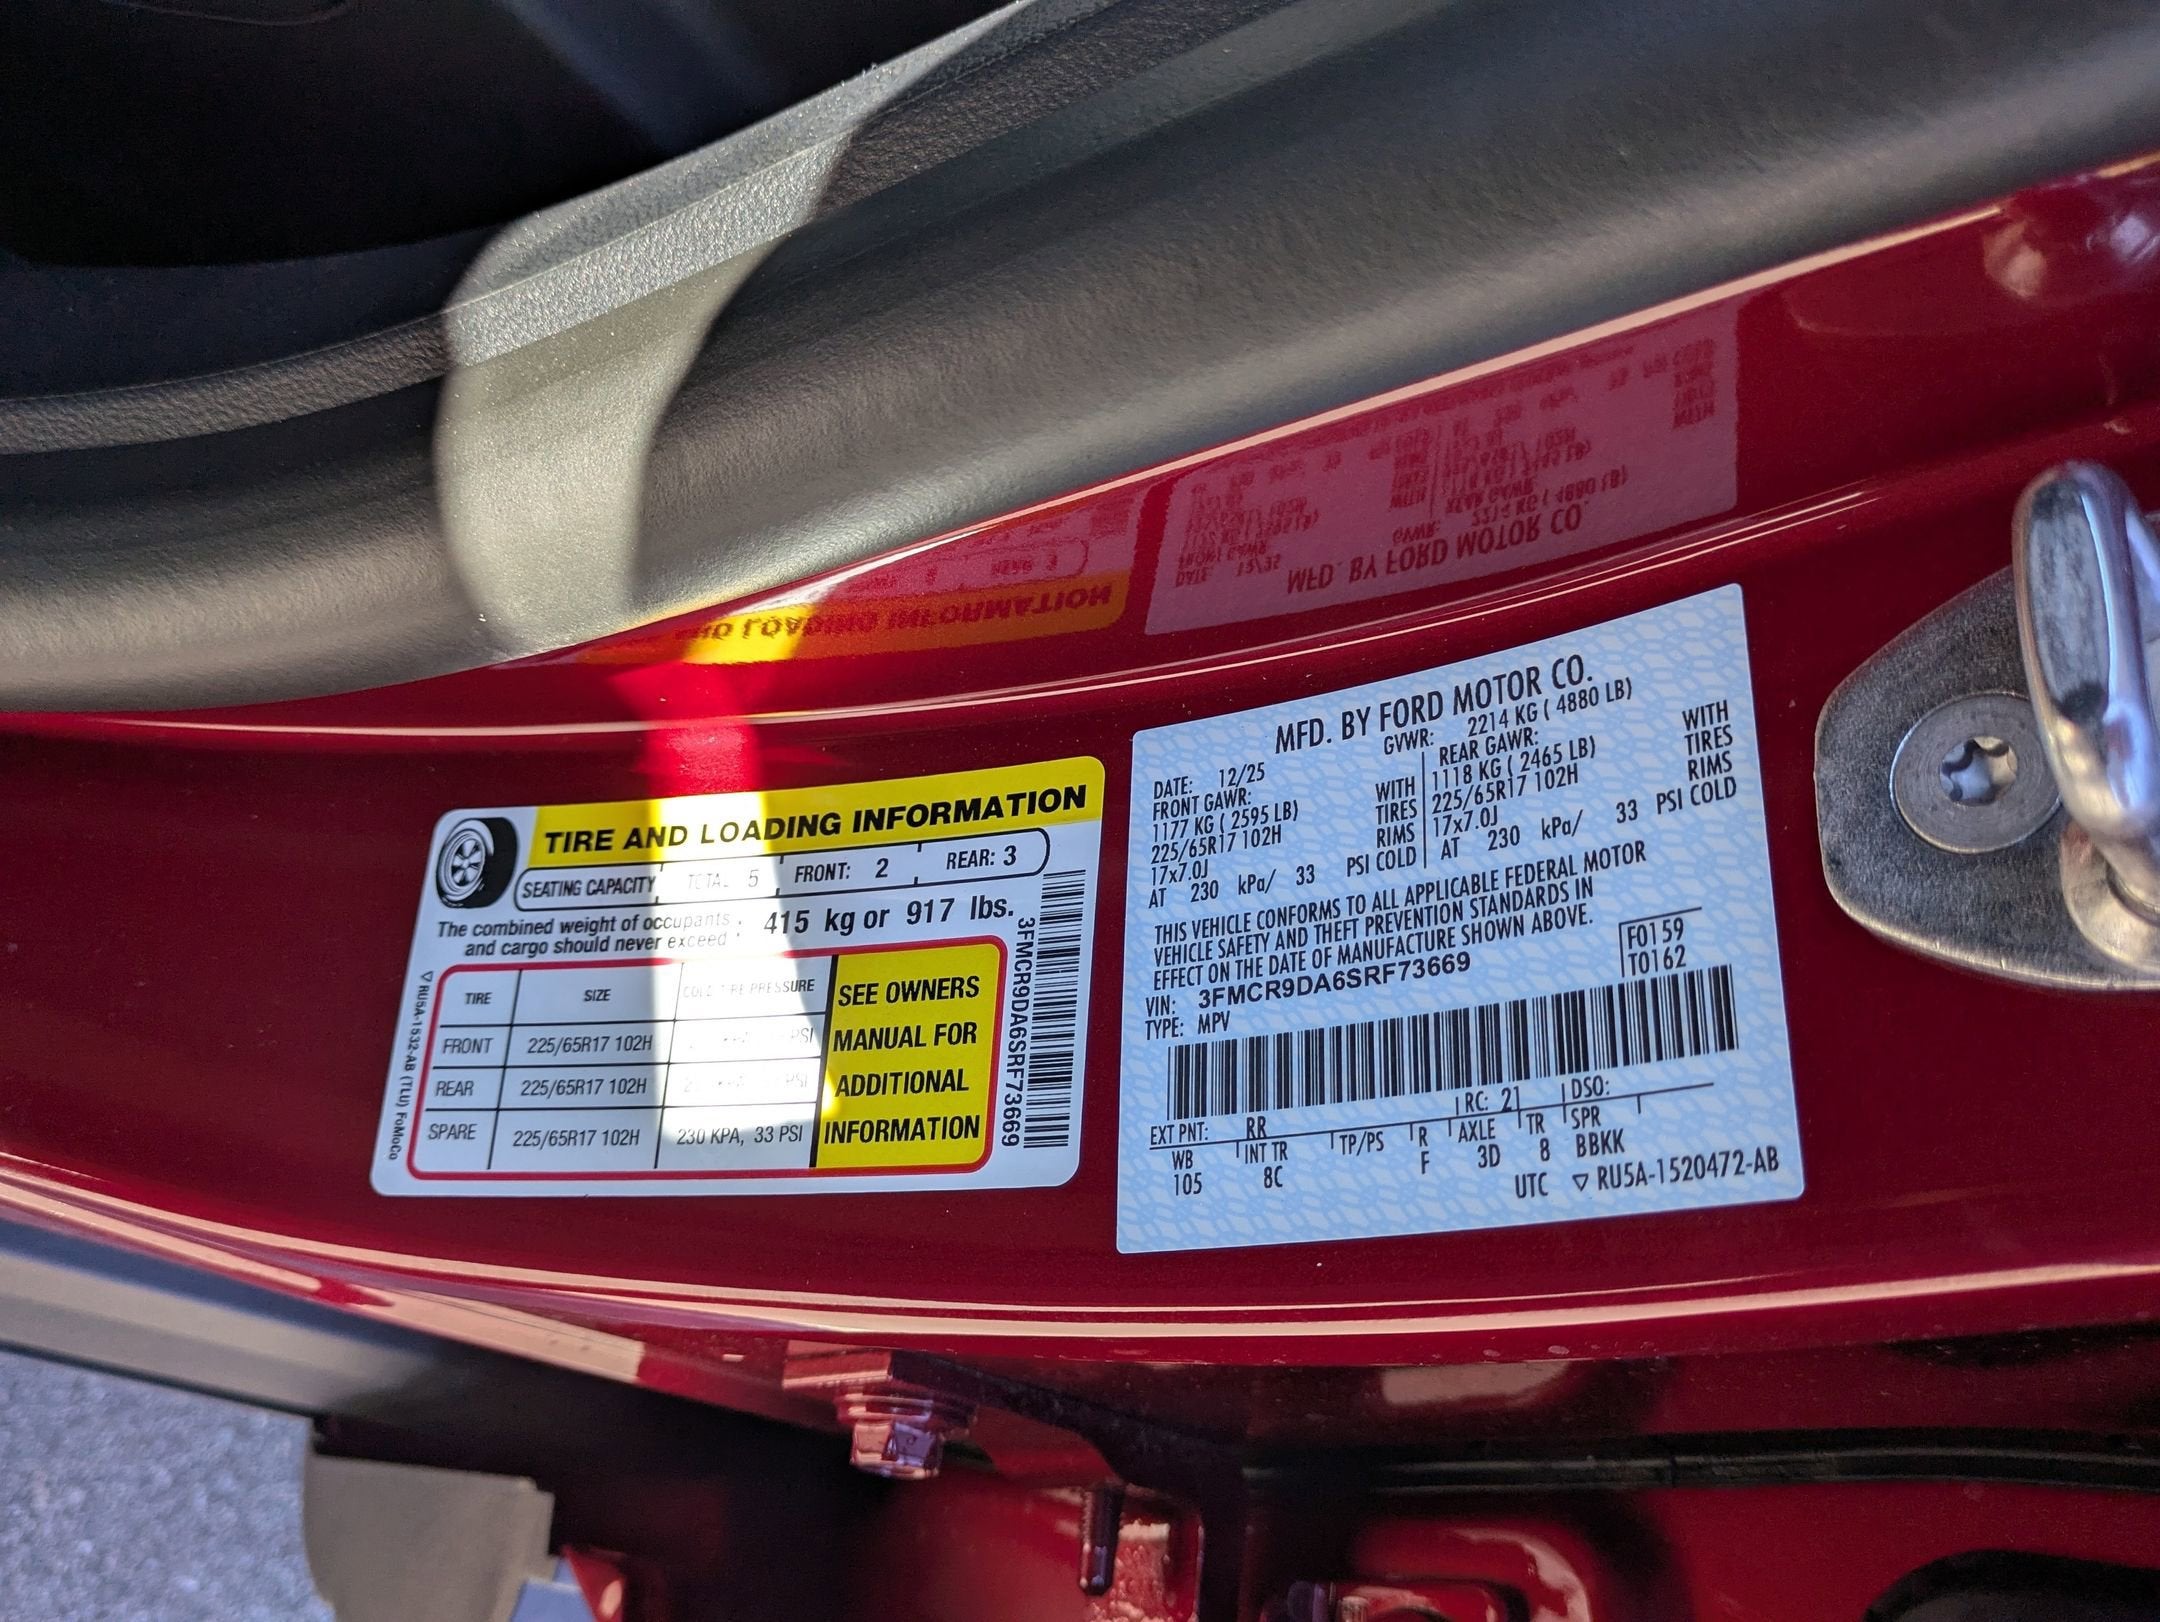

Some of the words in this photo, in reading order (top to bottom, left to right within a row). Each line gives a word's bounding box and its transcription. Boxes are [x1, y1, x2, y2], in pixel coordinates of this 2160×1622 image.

[1275, 718, 1332, 754] MFD.
[1342, 706, 1371, 740] BY
[1379, 690, 1444, 732] FORD
[1453, 666, 1542, 715] MOTOR
[1552, 654, 1593, 690] CO.
[1384, 728, 1435, 755] GVWR:
[1468, 709, 1508, 737] 2214
[1515, 702, 1538, 725] KG
[1556, 686, 1599, 715] 4880
[1605, 676, 1633, 703] LB)
[1682, 700, 1729, 731] WITH
[1439, 739, 1480, 767] REAR
[1485, 727, 1539, 756] GAWR:
[1684, 724, 1733, 756] TIRES
[1432, 764, 1473, 791] 1118
[1478, 757, 1501, 780] KG
[1520, 742, 1562, 773] 2465
[1568, 735, 1596, 762] LB)
[1687, 751, 1733, 782] RIMS
[1153, 776, 1193, 800] DATE:
[1218, 762, 1265, 789] 12/25
[1375, 775, 1415, 803] WITH
[1431, 774, 1527, 814] 225/65R17
[1536, 763, 1578, 793] 102H
[1153, 796, 1200, 821] FRONT
[1204, 788, 1252, 815] GAWR:
[1375, 799, 1417, 826] TIRES
[1441, 836, 1460, 860] AT
[1488, 825, 1521, 851] 230
[1541, 810, 1583, 840] kPa/
[1616, 799, 1639, 823] 33
[1656, 788, 1683, 815] PSI
[1690, 776, 1737, 806] COLD
[544, 828, 614, 854] TIRE
[623, 826, 688, 851] AND
[700, 813, 841, 844] LOADING
[853, 784, 1087, 834] INFORMATION
[1153, 818, 1188, 843] 1177
[1194, 814, 1214, 837] KG
[1231, 804, 1269, 831] 2595
[1274, 799, 1299, 823] LB)
[1433, 805, 1498, 837] 17x7.0J
[1150, 832, 1236, 865] 225/65R17
[1242, 824, 1282, 849] 102H
[1376, 823, 1415, 849] RIMS
[795, 862, 851, 883] FRONT:
[875, 858, 889, 879] 2
[946, 847, 996, 870] REAR:
[1003, 845, 1017, 866] 3
[748, 869, 760, 888] 5
[1149, 888, 1167, 909] AT
[1190, 880, 1219, 903] 230
[1238, 869, 1277, 895] kPa/
[1295, 863, 1316, 886] 33
[1346, 854, 1370, 877] PSI
[1376, 846, 1417, 872] COLD
[1150, 858, 1208, 886] 17x7.0J
[522, 878, 581, 899] SEATING
[586, 876, 656, 896] CAPACITY
[1155, 922, 1186, 945] THIS
[1192, 912, 1251, 940] VEHICLE
[1257, 898, 1341, 931] CONFORMS
[1346, 895, 1365, 917] TO
[1372, 887, 1400, 912] ALL
[1404, 870, 1499, 906] APPLICABLE
[1504, 855, 1577, 889] FEDERAL
[1584, 840, 1646, 874] MOTOR
[438, 920, 468, 937] The
[472, 917, 553, 937] combined
[560, 913, 616, 937] weight
[621, 912, 640, 931] of
[643, 912, 731, 932] occupants
[764, 909, 810, 935] 415
[825, 908, 855, 937] kg
[864, 908, 890, 930] or
[906, 898, 955, 925] 917
[970, 895, 1014, 921] lbs.
[1154, 940, 1213, 967] VEHICLE
[1218, 932, 1270, 959] SAFETY
[1275, 926, 1308, 950] AND
[1314, 919, 1359, 945] THEFT
[1364, 903, 1464, 934] PREVENTION
[1470, 881, 1570, 918] STANDARDS
[1575, 876, 1594, 900] IN
[465, 940, 497, 957] and
[502, 940, 548, 959] cargo
[553, 934, 610, 953] should
[615, 936, 662, 952] never
[668, 932, 727, 950] exceed
[1154, 964, 1202, 991] EFFECT
[1208, 962, 1230, 985] ON
[1235, 956, 1264, 981] THE
[1268, 951, 1306, 976] DATE
[1312, 946, 1332, 969] OF
[1337, 926, 1456, 967] MANUFACTURE
[1462, 918, 1525, 947] SHOWN
[1531, 903, 1594, 936] ABOVE.
[464, 992, 492, 1005] TIRE
[583, 989, 611, 1002] SIZE
[750, 978, 815, 994] PRESSURE
[838, 983, 879, 1007] SEE
[886, 976, 980, 1004] OWNERS
[1145, 995, 1176, 1018] VIN:
[1198, 951, 1471, 1009] 3FMCR9DA6SRF73669
[833, 1024, 926, 1052] MANUAL
[934, 1021, 977, 1046] FOR
[1001, 916, 1036, 1148] 3FMCR9DA6SRF73669
[1145, 1018, 1184, 1041] TYPE:
[1197, 1011, 1231, 1035] MPV
[442, 1037, 494, 1054] FRONT
[527, 1035, 612, 1056] 225/65R17
[615, 1034, 653, 1051] 102H
[395, 1075, 413, 1108] (TLU)
[435, 1080, 474, 1097] REAR
[520, 1078, 604, 1099] 225/65R17
[608, 1077, 647, 1095] 102H
[835, 1068, 969, 1098] ADDITIONAL
[1571, 1075, 1610, 1099] DSO:
[1464, 1091, 1489, 1113] RC:
[1501, 1086, 1521, 1113] 21
[428, 1123, 477, 1140] SPARE
[824, 1115, 980, 1144] INFORMATION
[1150, 1124, 1175, 1145] EXT
[1179, 1122, 1209, 1143] PNT:
[1246, 1116, 1266, 1140] RR
[1458, 1118, 1496, 1143] AXLE
[1526, 1113, 1545, 1135] TR
[1571, 1106, 1602, 1129] SPR
[388, 1111, 408, 1160] FoMoCo
[512, 1129, 597, 1150] 225/65R17
[602, 1129, 640, 1146] 102H
[677, 1128, 705, 1145] 230
[710, 1127, 745, 1147] KPA,
[754, 1126, 774, 1143] 33
[780, 1125, 803, 1142] PSI
[1339, 1131, 1385, 1156] TP/PS
[1418, 1126, 1428, 1147] R
[1576, 1128, 1625, 1158] BBKK
[1172, 1150, 1194, 1170] WB
[1245, 1143, 1267, 1164] INT
[1273, 1141, 1288, 1162] TR
[1421, 1151, 1430, 1175] F
[1477, 1145, 1501, 1169] 3D
[1540, 1138, 1550, 1162] 8
[1173, 1172, 1202, 1196] 105
[1263, 1166, 1283, 1189] 8C
[1515, 1172, 1549, 1199] UTC
[1597, 1146, 1780, 1191] RU5A-1520472-AB
